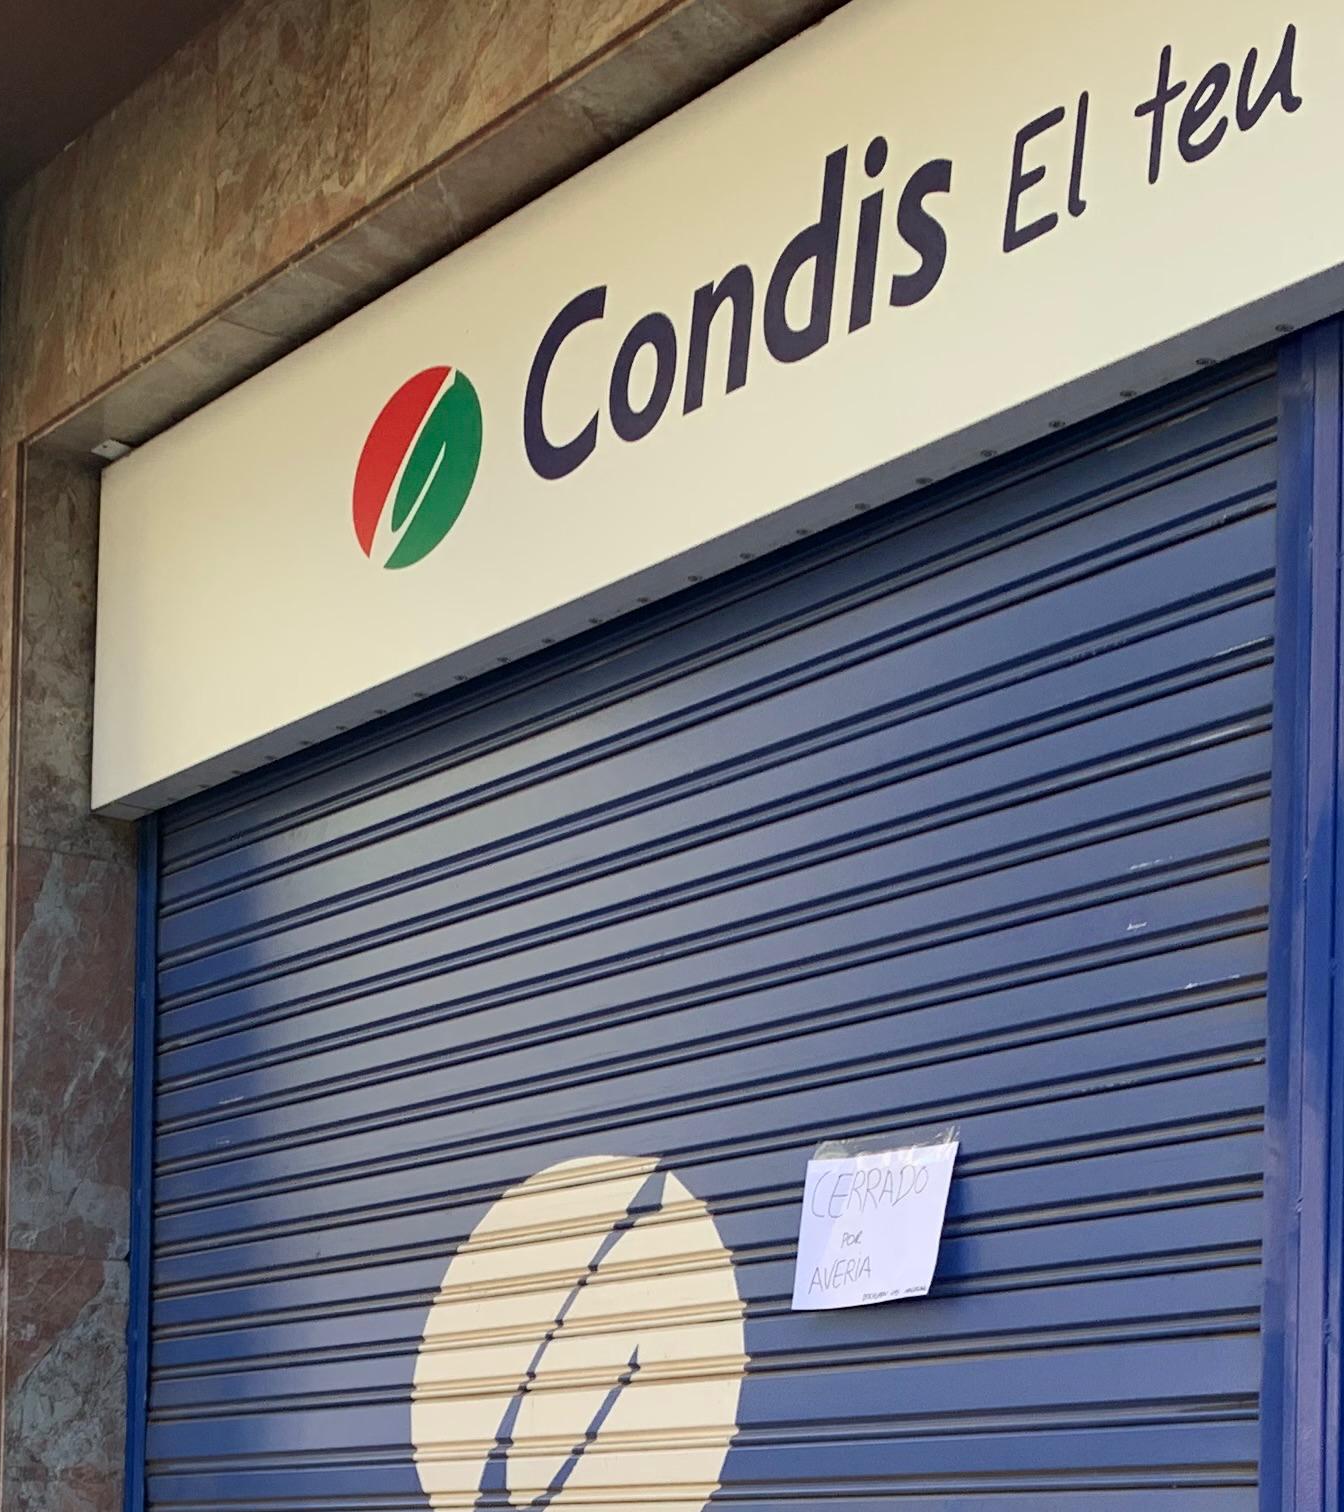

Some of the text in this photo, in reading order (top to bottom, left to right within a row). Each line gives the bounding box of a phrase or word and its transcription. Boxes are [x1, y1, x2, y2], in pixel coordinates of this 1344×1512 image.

[523, 136, 952, 480] Condis
[1002, 90, 1089, 253] El
[1134, 23, 1303, 185] teu
[811, 1164, 929, 1219] CERRADO
[840, 1230, 863, 1249] POR
